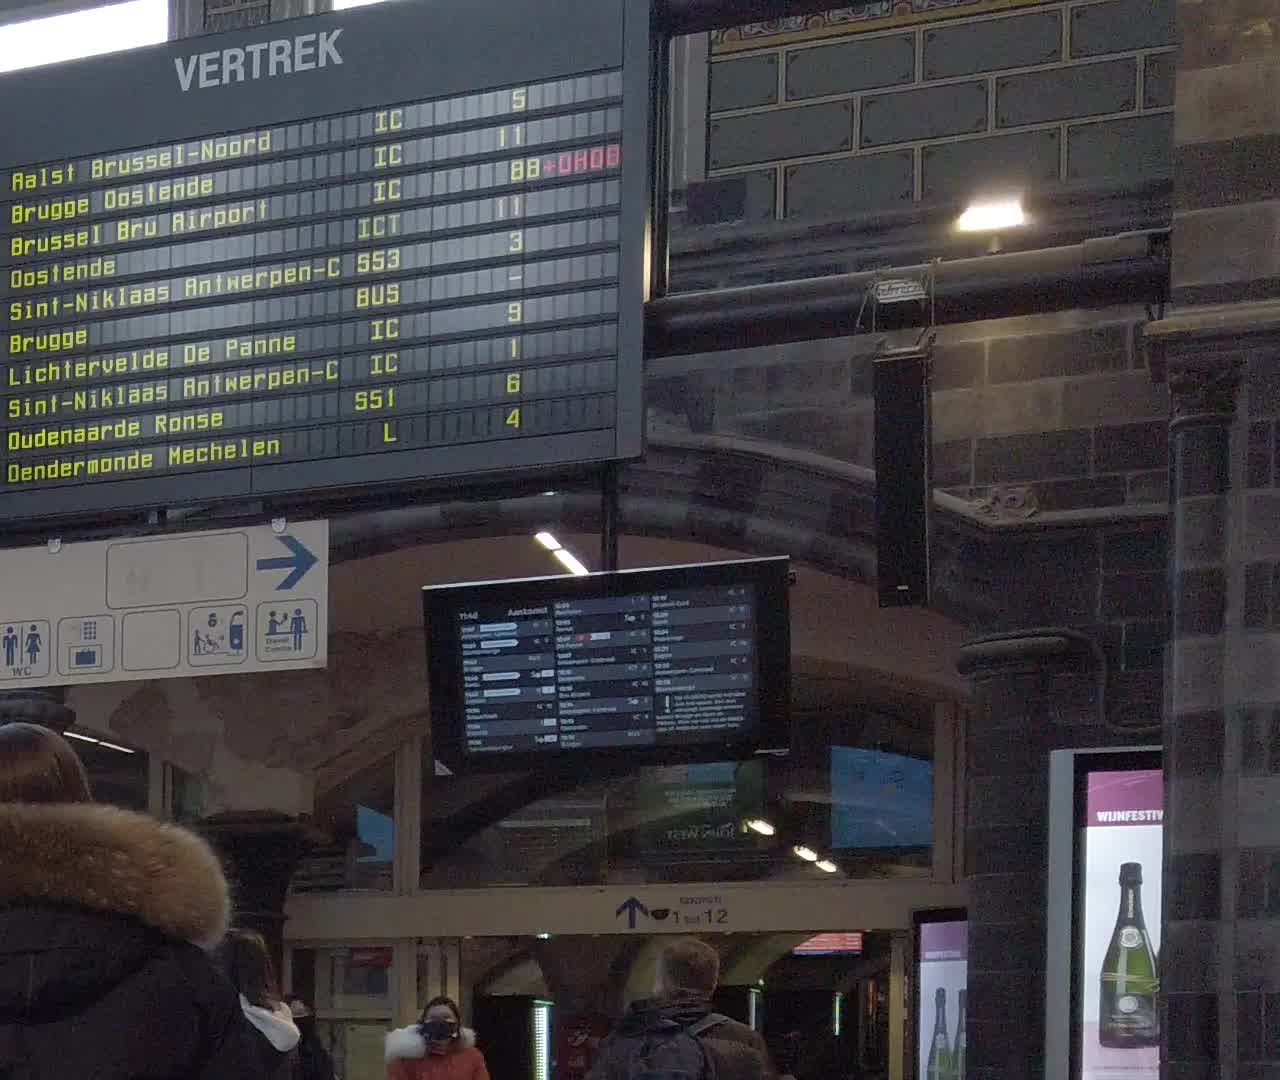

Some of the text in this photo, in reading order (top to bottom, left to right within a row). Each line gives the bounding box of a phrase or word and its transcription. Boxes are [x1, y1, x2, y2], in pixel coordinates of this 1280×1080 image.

[175, 29, 344, 91] VERTREK
[12, 161, 76, 192] Aalst
[92, 130, 270, 179] Brussel-Noord
[374, 108, 403, 134] IC
[511, 88, 526, 112] 5
[11, 223, 102, 257] Brussel
[118, 215, 156, 241] Bru
[173, 198, 269, 233] Airport
[373, 178, 402, 203] IC
[12, 192, 89, 224] Brugge
[105, 173, 213, 210] Oostende
[373, 143, 403, 169] IC
[10, 254, 115, 290] Oostende
[357, 212, 401, 240] ICT
[10, 280, 169, 322] Sint-Niklaas
[185, 256, 340, 298] Antwerpen-C
[508, 230, 523, 254] 3
[9, 325, 86, 355] Brugge
[356, 282, 400, 309] BUS
[9, 347, 168, 388] Lichtervelde
[184, 342, 209, 365] De
[226, 331, 295, 360] Panne
[370, 317, 399, 342] IC
[507, 301, 521, 325] 9
[8, 380, 167, 420] Sint-Niklaas
[183, 359, 338, 399] Antwerpen-C
[369, 352, 398, 377] IC
[8, 417, 139, 453] Oudenaarde
[155, 407, 222, 436] Ronse
[505, 372, 520, 396] 6
[7, 449, 152, 485] Dendermonde
[168, 435, 278, 468] Mechelen
[383, 421, 397, 444] L
[505, 408, 519, 431] 4
[13, 665, 32, 677] WC
[704, 910, 728, 924] 12
